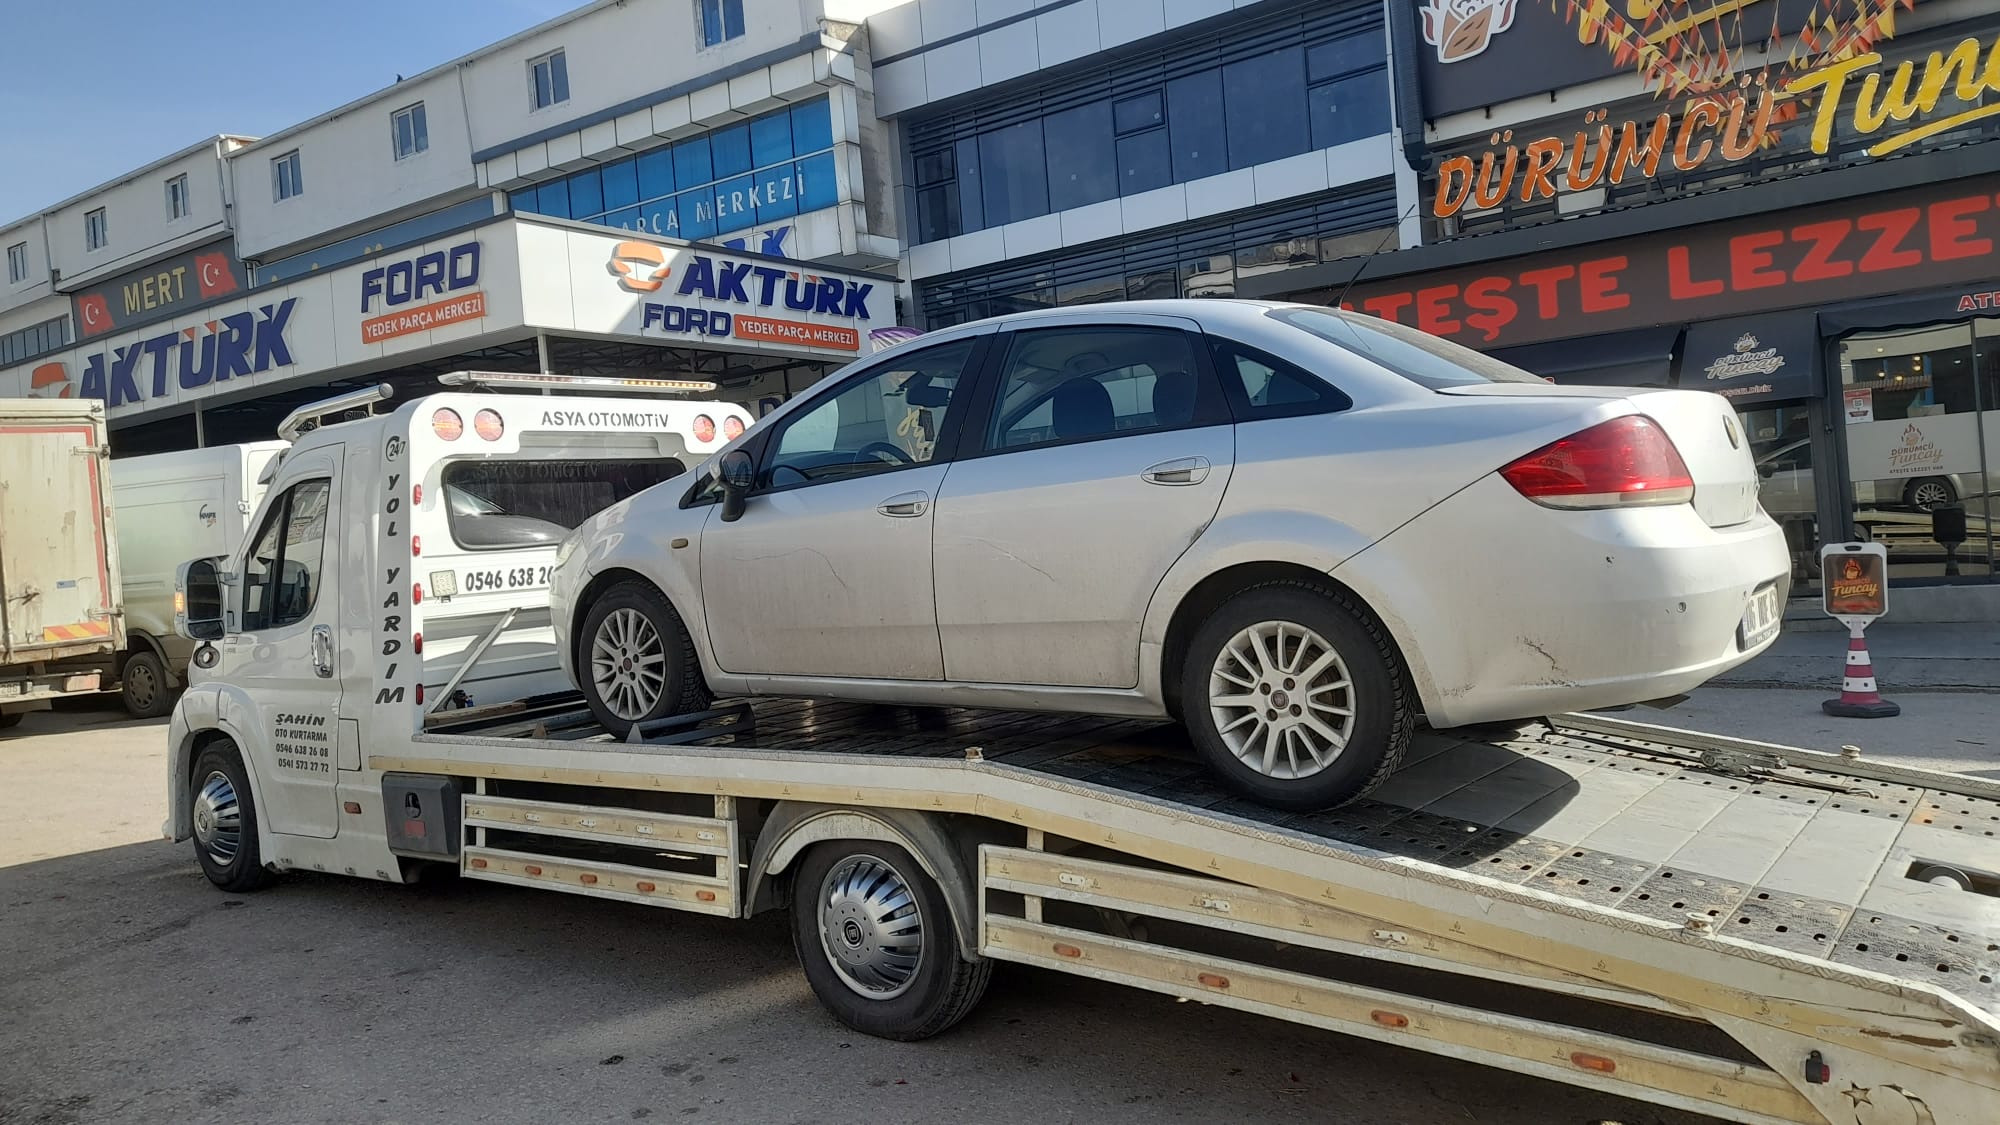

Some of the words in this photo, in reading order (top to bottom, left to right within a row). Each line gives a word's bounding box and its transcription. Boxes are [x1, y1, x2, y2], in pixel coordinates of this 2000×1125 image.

[1434, 72, 1775, 217] DÜRÜMCÜ
[1785, 36, 2000, 155] Tun
[697, 167, 804, 223] MERKEZİ
[361, 241, 480, 313] FORD
[678, 256, 873, 320] AKTÜRK
[1340, 256, 1630, 341] TEŞTE
[1668, 192, 2000, 300] LEZZE
[123, 266, 186, 316] MERT
[365, 320, 398, 338] YEDEK
[400, 311, 434, 330] PARÇA
[435, 295, 481, 322] MERKEZİ
[644, 303, 731, 336] FORD
[740, 320, 775, 336] YEDEK
[778, 326, 812, 342] PARÇA
[814, 329, 854, 345] MERKEZİ
[79, 297, 298, 408] AKTÜRK
[541, 411, 586, 426] ASYA
[386, 473, 400, 537] YOL
[465, 571, 503, 592] 0546
[508, 567, 534, 587] 638
[1831, 583, 1879, 598] Tuncay
[375, 567, 405, 705] YARDIM
[275, 713, 325, 726] ŞAHİN
[275, 728, 288, 738] OTO
[289, 729, 328, 742] KURTARMA
[275, 743, 293, 754] 0546
[294, 744, 307, 755] 638
[309, 746, 318, 756] 26
[319, 747, 329, 757] 08
[278, 758, 294, 769] 0541
[296, 760, 308, 770] 573
[310, 761, 319, 771] 27
[320, 763, 329, 773] 72
